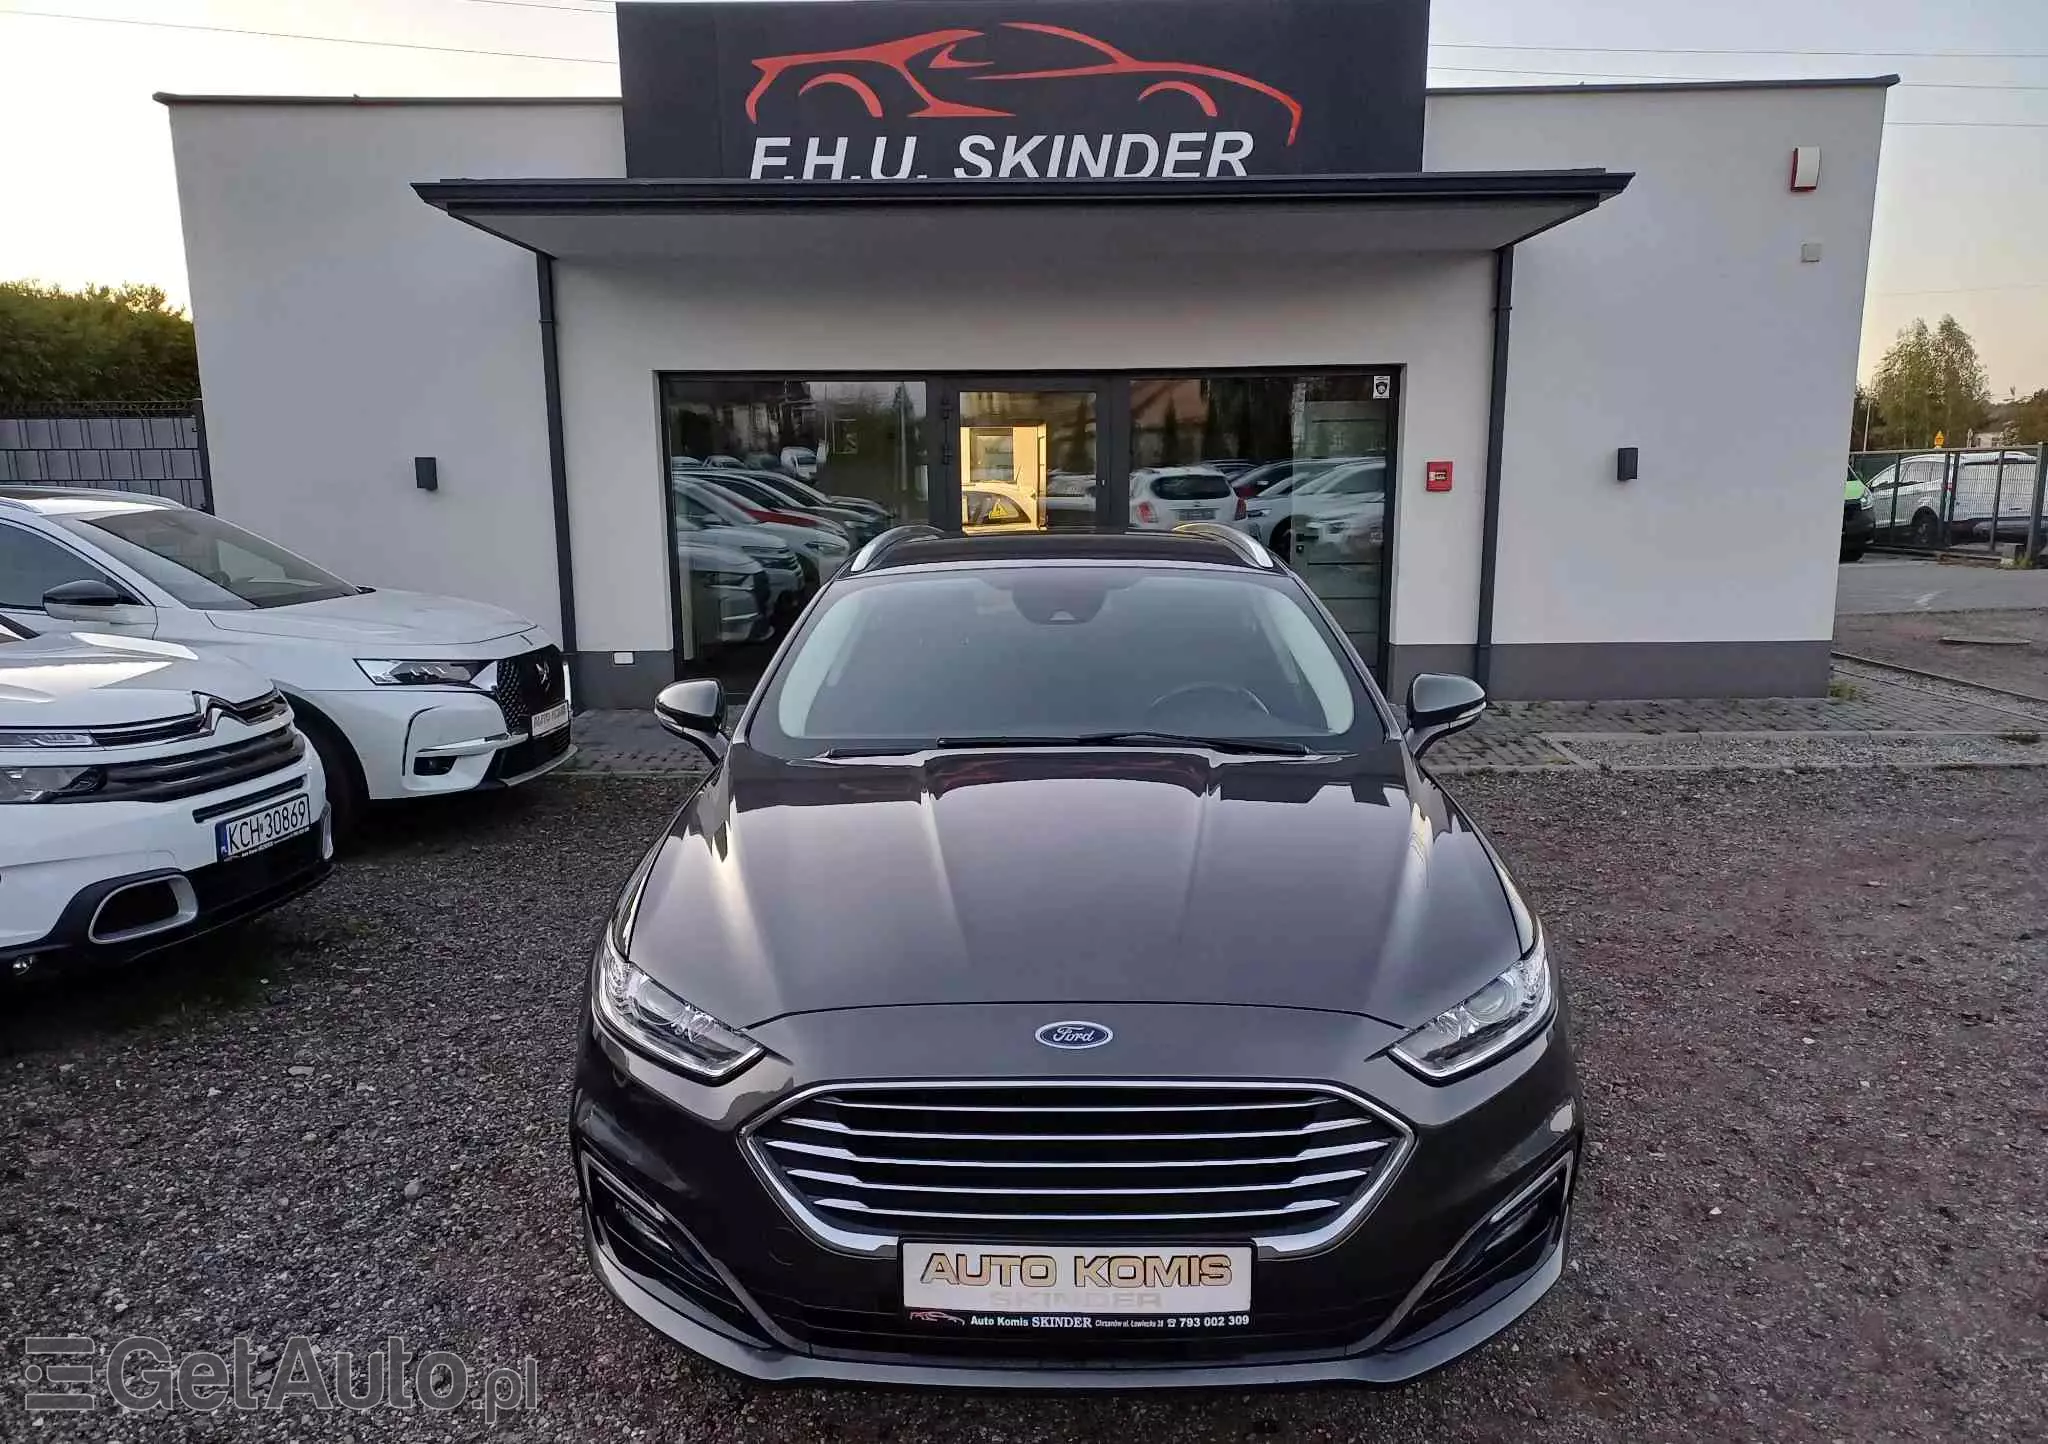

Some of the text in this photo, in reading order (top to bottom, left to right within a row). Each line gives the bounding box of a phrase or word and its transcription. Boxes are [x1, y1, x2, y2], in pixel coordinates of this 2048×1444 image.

[750, 131, 1254, 180] F.H.U. SKINDER
[264, 801, 306, 838] 30869
[1053, 1026, 1095, 1042] Ford
[921, 1252, 1233, 1288] AUTO KOMIS
[988, 1291, 1163, 1309] SKINDER
[970, 1315, 994, 1326] Auto
[997, 1316, 1029, 1327] Komis
[1031, 1316, 1092, 1328] SKINDER
[1179, 1317, 1201, 1328] 793
[1203, 1316, 1225, 1328] 002
[1228, 1314, 1250, 1326] 309
